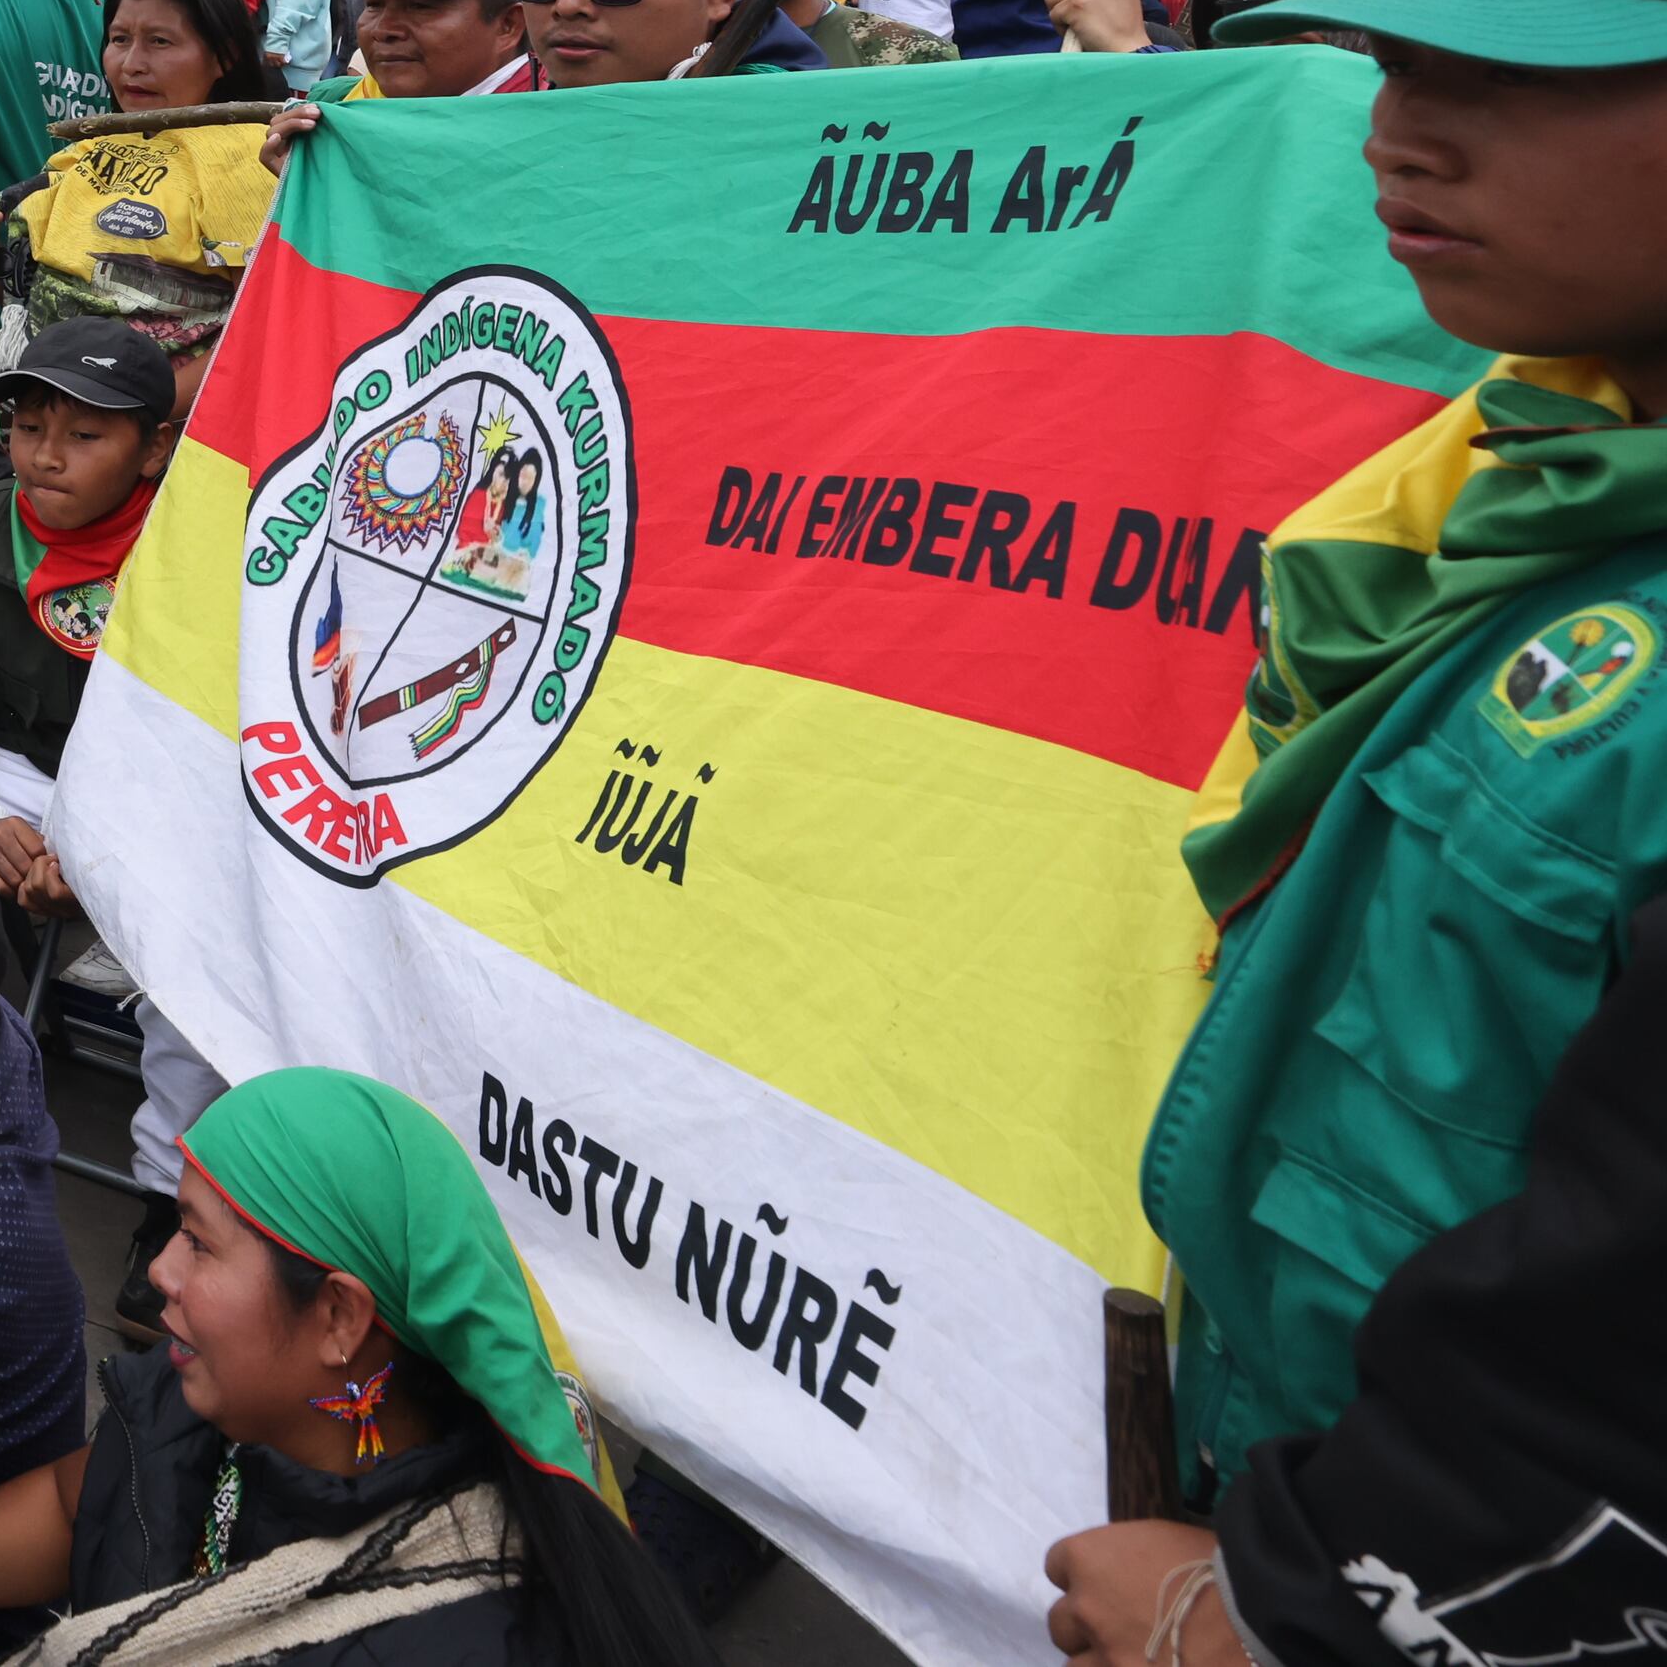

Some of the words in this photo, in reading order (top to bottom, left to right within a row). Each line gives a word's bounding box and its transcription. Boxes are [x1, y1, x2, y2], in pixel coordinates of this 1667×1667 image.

[35, 60, 111, 100] GUARDI
[42, 90, 113, 121] NDÍGEN
[405, 295, 567, 393] INDÍGENA
[531, 370, 612, 727] KURMADÓ
[704, 465, 807, 556] DAI
[795, 474, 1078, 601] EMBERA
[478, 1070, 665, 1270] DASTU
